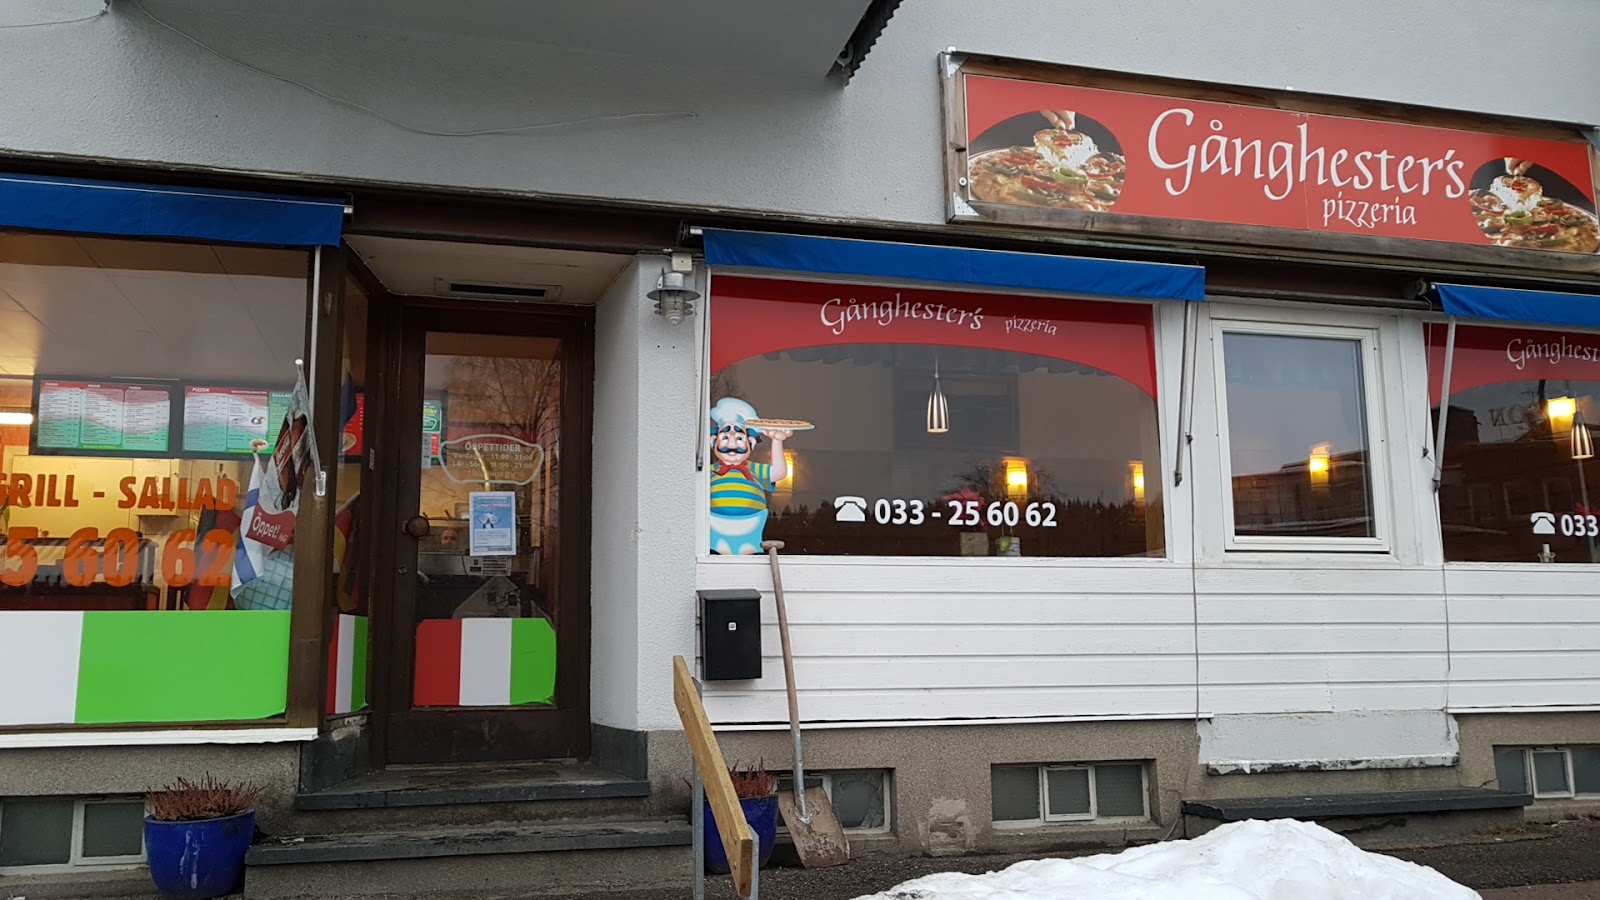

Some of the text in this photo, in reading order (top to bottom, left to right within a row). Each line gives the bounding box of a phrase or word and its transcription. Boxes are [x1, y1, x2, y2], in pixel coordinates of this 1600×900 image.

[1322, 190, 1418, 229] pizzeria
[1005, 315, 1058, 336] pizzeria
[118, 476, 238, 511] SALLAD
[252, 512, 281, 539] Öppet!
[874, 498, 925, 526] 033
[948, 499, 979, 527] 25
[987, 500, 1020, 527] 60
[1025, 501, 1057, 528] 62
[1561, 514, 1599, 537] 033
[63, 527, 140, 587] 60
[161, 528, 234, 588] 62
